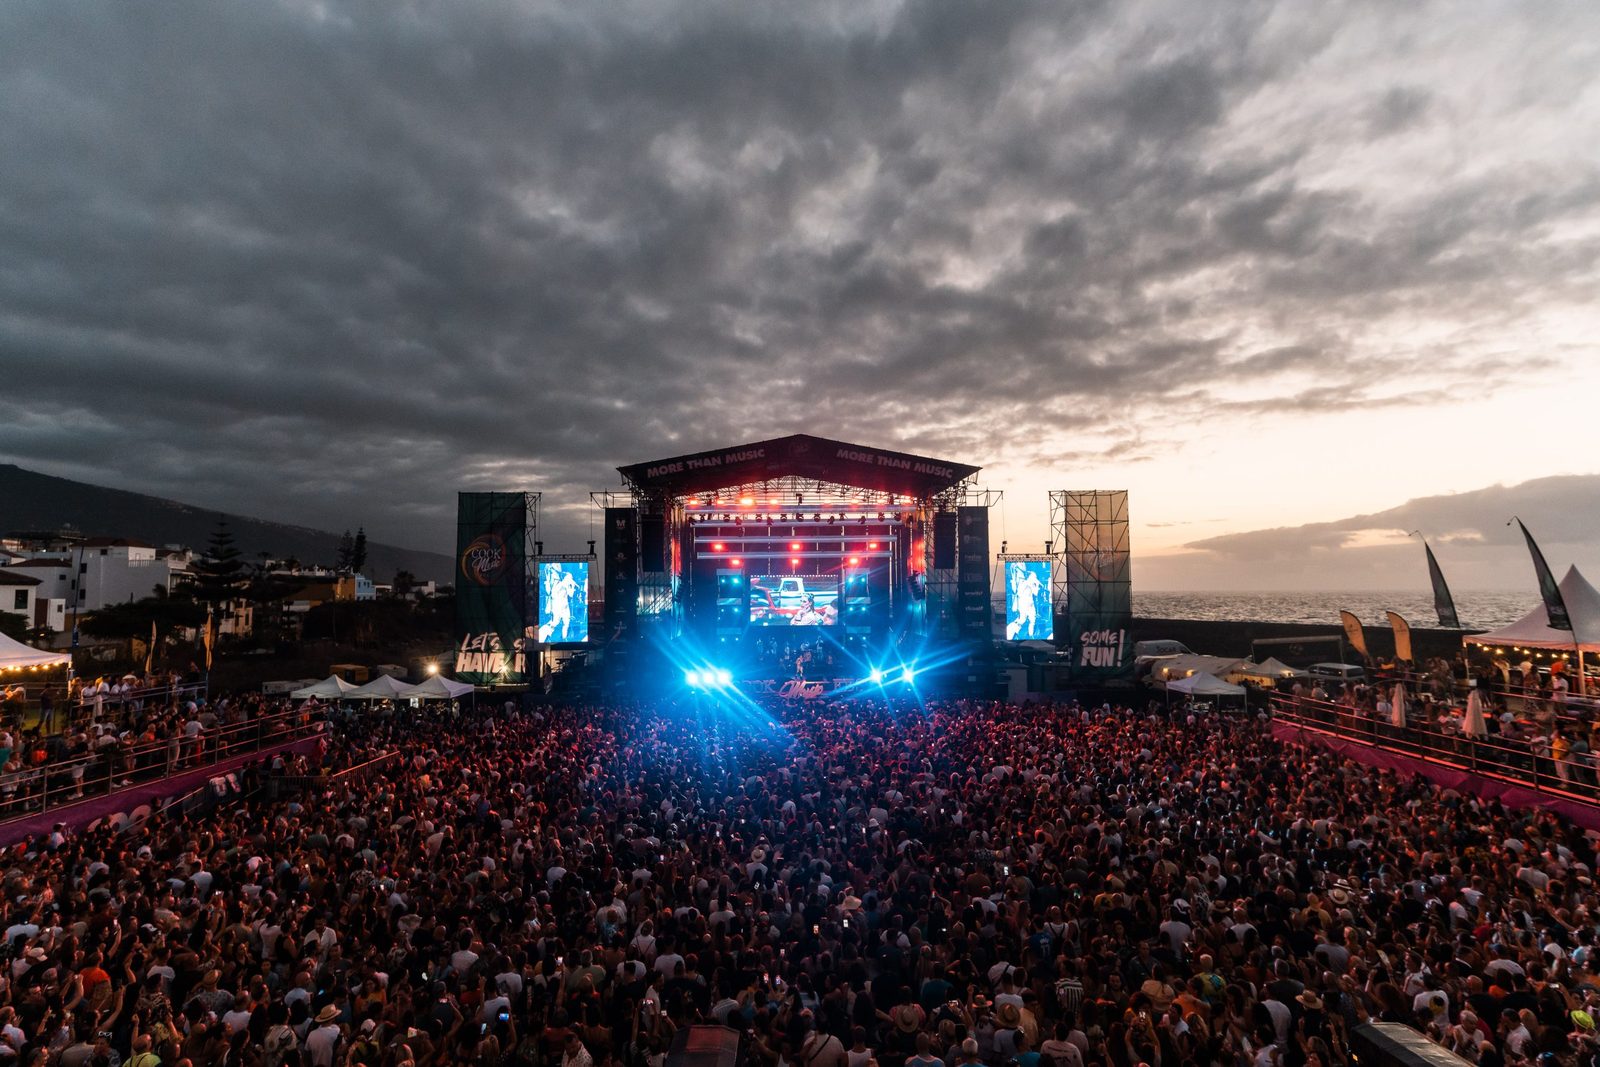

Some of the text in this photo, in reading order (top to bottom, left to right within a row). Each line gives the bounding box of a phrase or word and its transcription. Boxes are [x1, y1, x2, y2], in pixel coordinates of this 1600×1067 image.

[647, 449, 765, 479] MORE THAN MUSIC
[836, 448, 954, 479] MORE THAN MUSIC
[471, 548, 502, 560] COOK
[1080, 629, 1119, 647] SOME
[456, 652, 504, 673] HAVE
